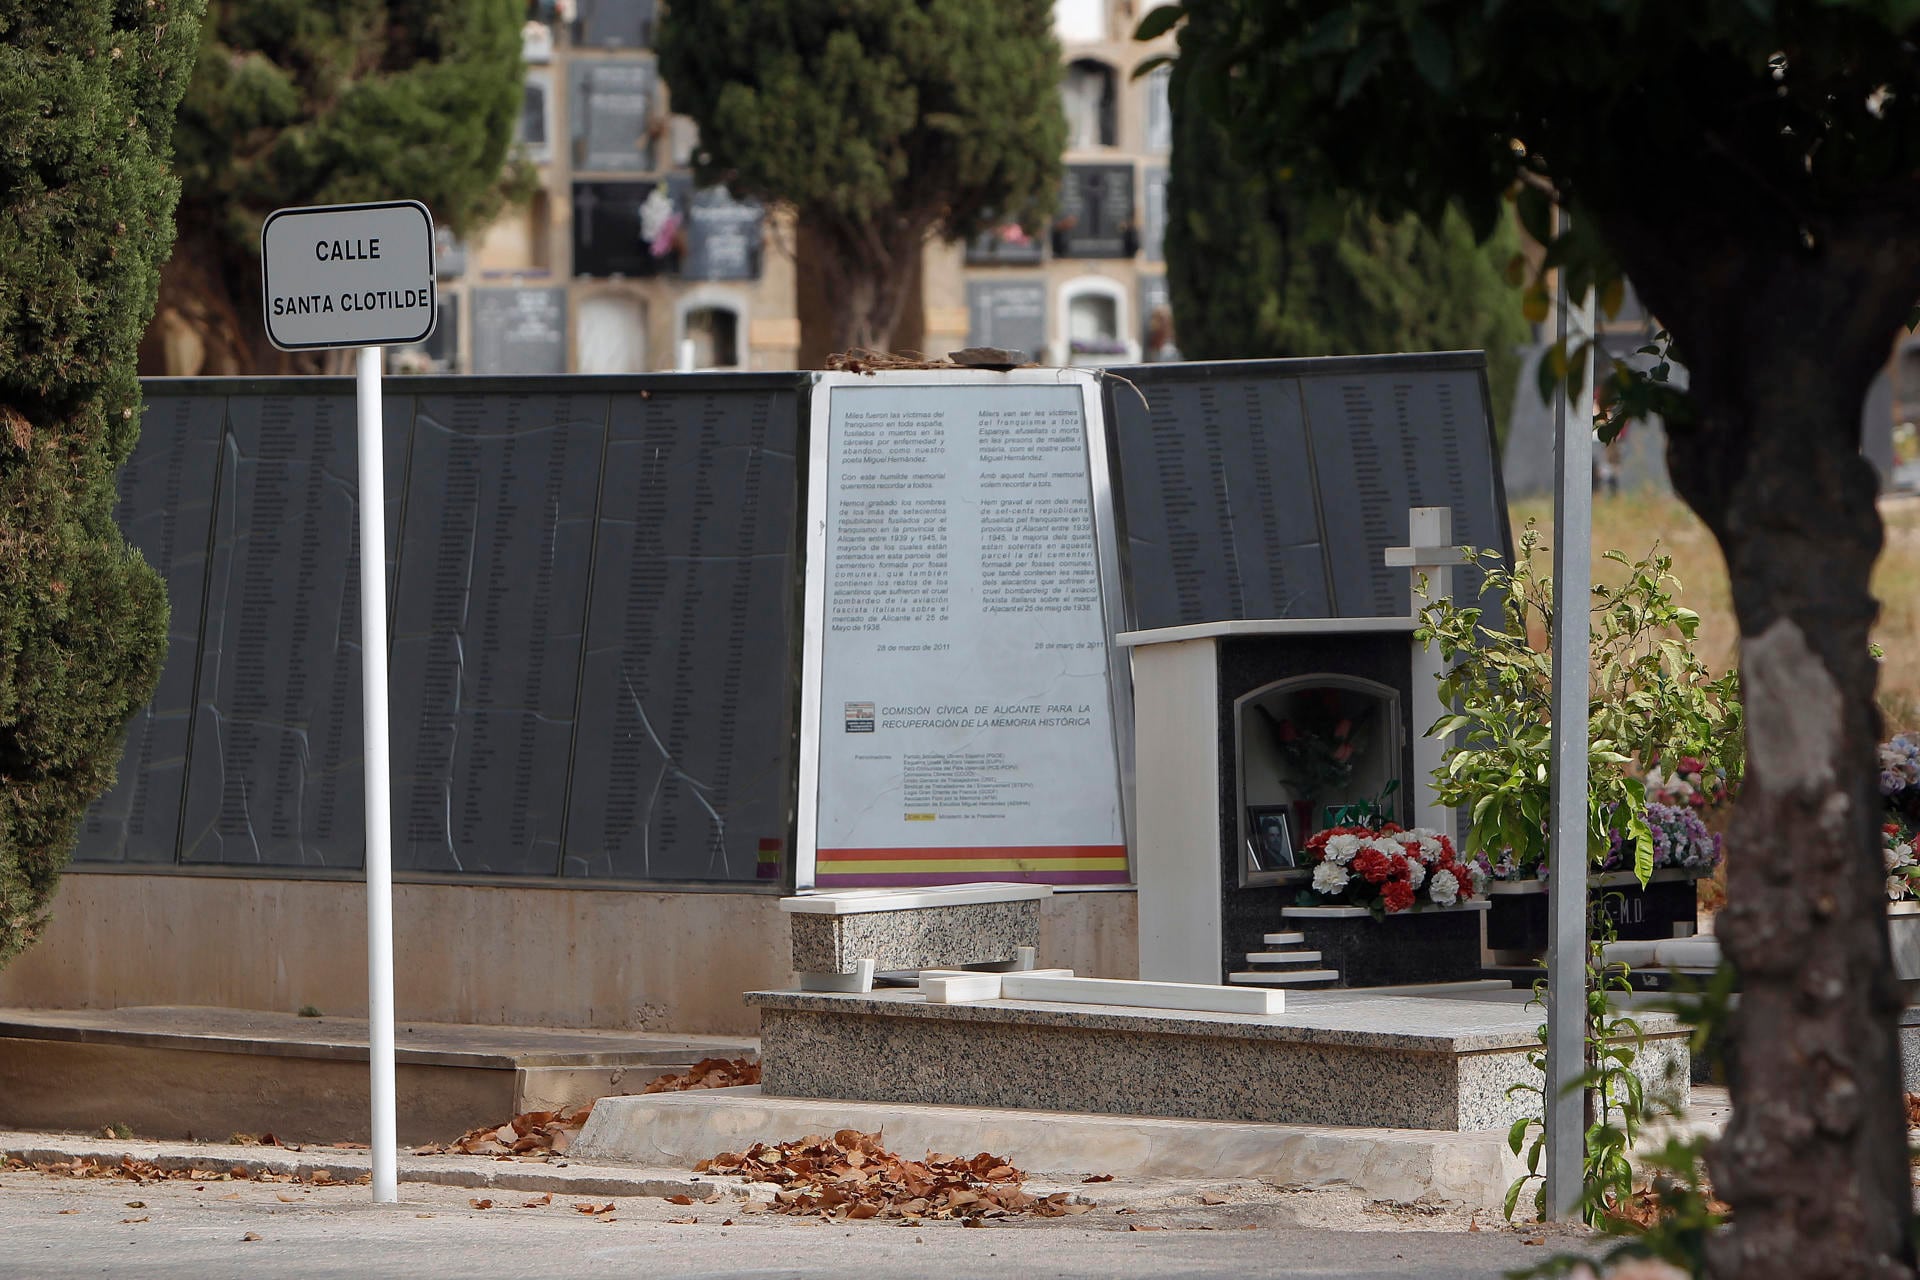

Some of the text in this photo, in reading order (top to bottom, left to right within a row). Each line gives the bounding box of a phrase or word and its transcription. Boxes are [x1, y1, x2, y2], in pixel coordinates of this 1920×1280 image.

[316, 239, 381, 261] CALLE
[273, 289, 428, 315] SANTA CLOTILDE
[882, 706, 930, 715] COMISIÓN
[937, 706, 968, 714] CÍVICA
[881, 719, 958, 728] RECUPERACIÓN
[1039, 717, 1090, 726] HISTÓRICA
[1592, 898, 1646, 926] S-M.D.
